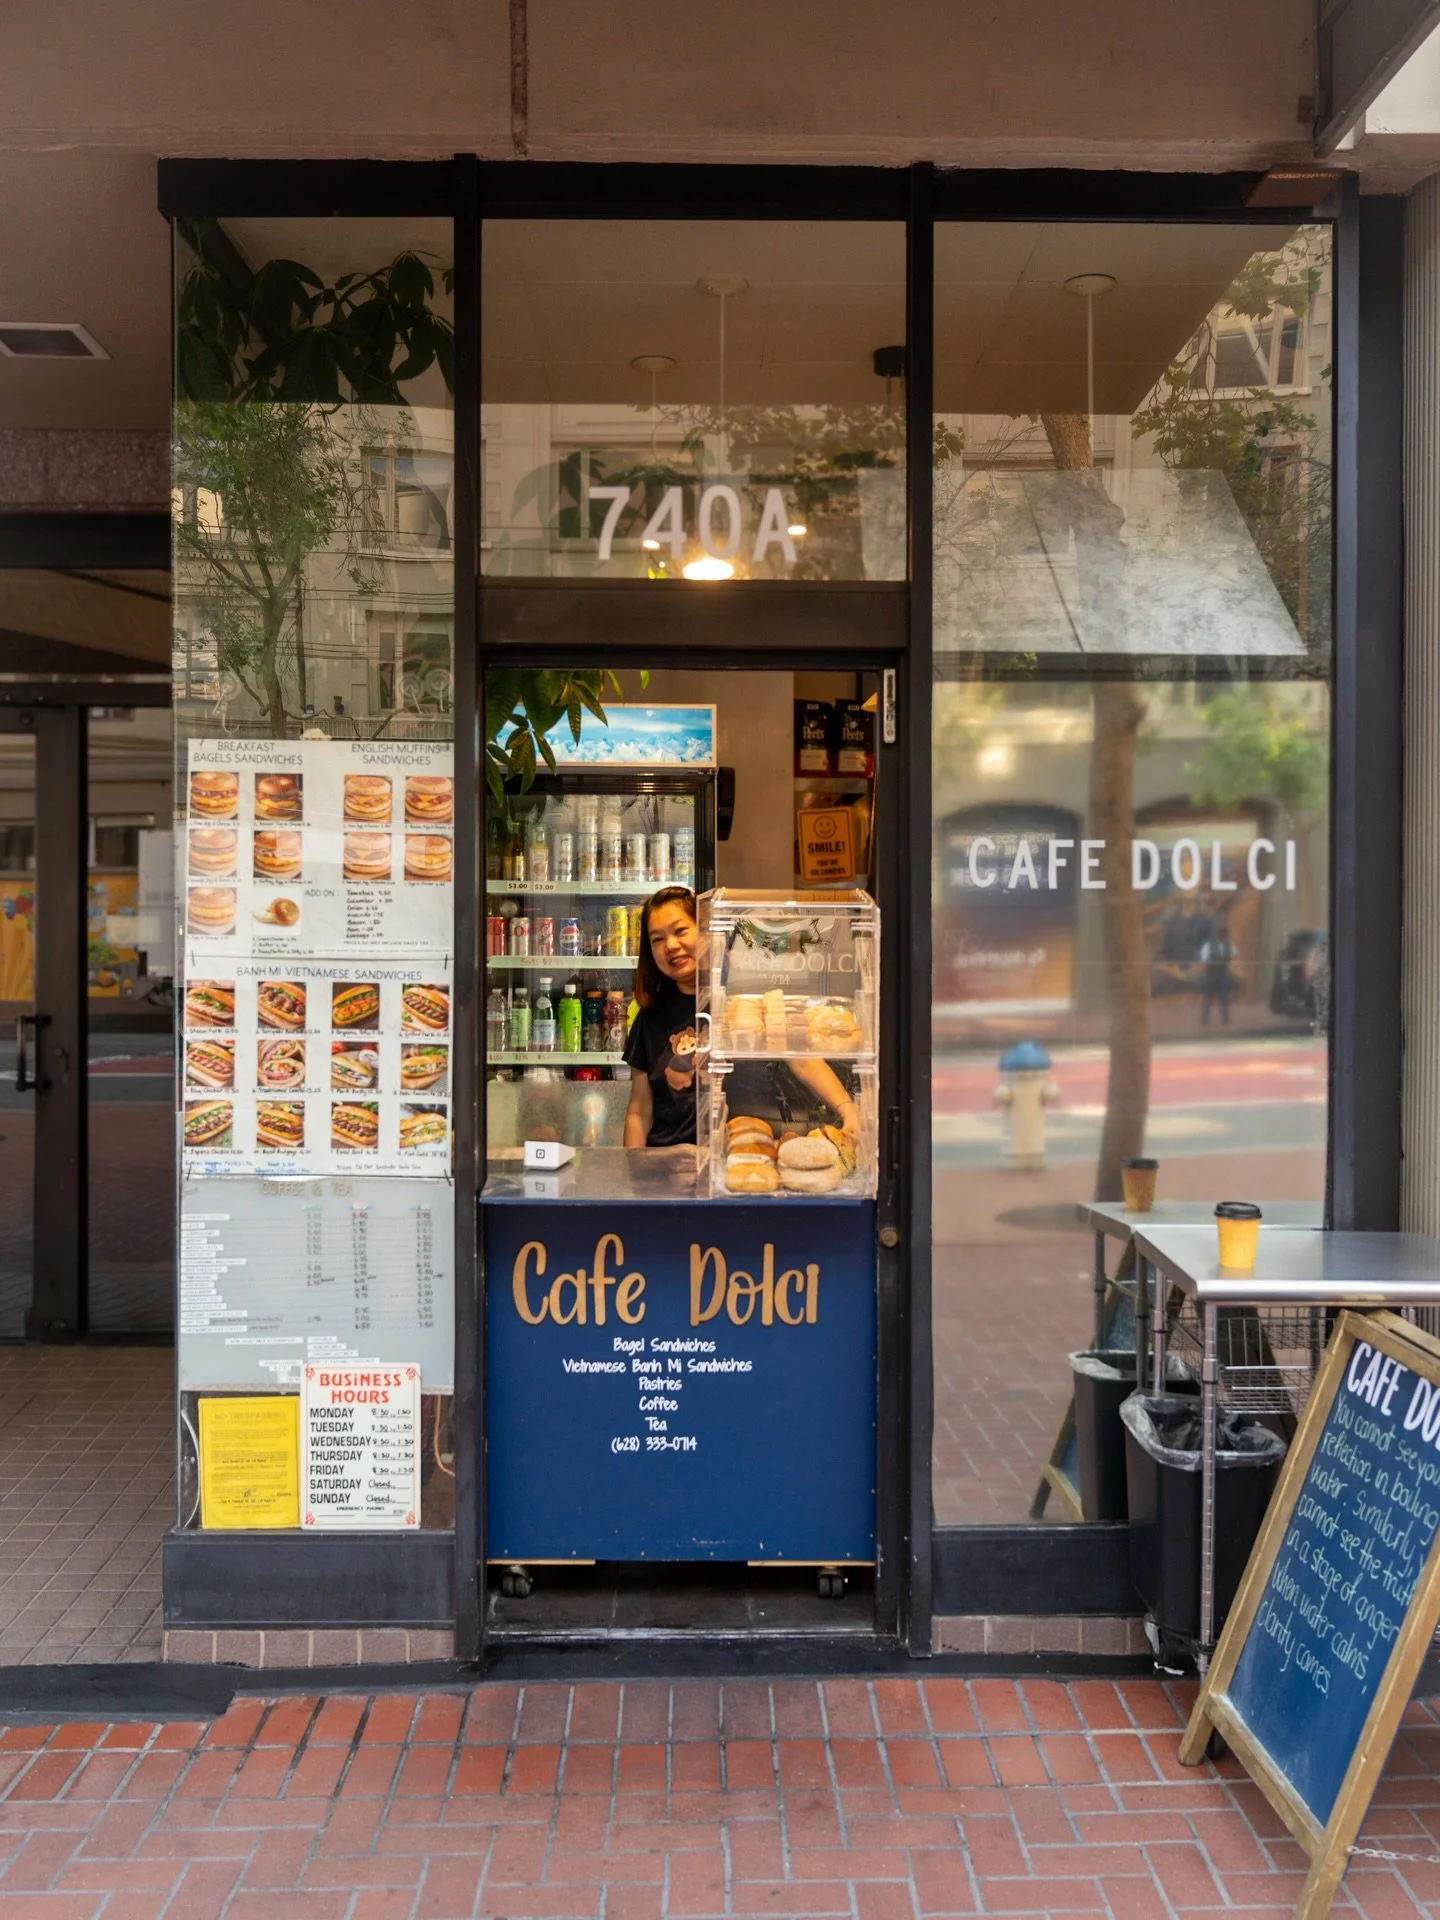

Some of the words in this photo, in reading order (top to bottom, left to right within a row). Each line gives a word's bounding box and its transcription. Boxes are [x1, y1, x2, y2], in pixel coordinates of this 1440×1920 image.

[589, 485, 797, 562] 740A
[217, 741, 275, 752] BREAKFAST
[351, 743, 394, 753] ENGLISH
[396, 744, 441, 754] MUFFINS
[193, 752, 232, 762] BAGELS
[234, 753, 303, 765] SANDWICHES
[362, 754, 431, 765] SANDWICHES
[808, 841, 845, 854] SMILE!
[968, 837, 1107, 890] CAFE
[1132, 838, 1296, 891] DOLCI
[304, 889, 321, 897] ADD
[236, 966, 267, 977] BANH
[268, 967, 282, 977] MI
[286, 968, 350, 979] VIETNAMESE
[355, 969, 423, 981] SANDWICHES
[512, 1232, 646, 1327] Cafe
[688, 1241, 821, 1328] Dolci
[613, 1337, 645, 1356] Bagel
[650, 1337, 716, 1353] Sandwiches
[562, 1358, 627, 1374] Vietnamese
[632, 1359, 662, 1374] Banh
[668, 1359, 682, 1374] Mi
[687, 1357, 753, 1373] Sandwiches
[638, 1376, 682, 1391] Pastries
[331, 1389, 390, 1405] HOURS
[639, 1396, 679, 1411] Coffee
[1347, 1342, 1409, 1417] CAFE
[1403, 1377, 1440, 1452] DO
[310, 1407, 354, 1418] MONDAY
[310, 1422, 355, 1432] TUESDAY
[645, 1416, 667, 1432] Tea
[1333, 1392, 1355, 1431] You
[1354, 1415, 1397, 1453] cannot
[1394, 1439, 1419, 1471] see
[310, 1435, 372, 1447] WEDNESDAY
[611, 1436, 640, 1453] (628)
[646, 1436, 697, 1451] 333-0714
[310, 1450, 363, 1461] THURSDAY
[310, 1464, 345, 1475] FRIDAY
[310, 1479, 362, 1489] SATURDAY
[368, 1479, 391, 1489] Closed
[1320, 1430, 1372, 1483] reflection
[1374, 1467, 1390, 1496] in
[1389, 1471, 1439, 1546] boiling
[310, 1493, 351, 1504] SUNDAY
[365, 1493, 391, 1503] Closed
[1297, 1493, 1341, 1539] cannot
[1340, 1528, 1361, 1561] see
[1360, 1537, 1382, 1580] the
[1286, 1520, 1300, 1552] in
[1299, 1540, 1310, 1564] a
[1311, 1546, 1342, 1601] stage
[1340, 1572, 1363, 1607] of
[1355, 1596, 1400, 1650] anger
[1299, 1594, 1335, 1639] water
[1257, 1597, 1296, 1673] clarity
